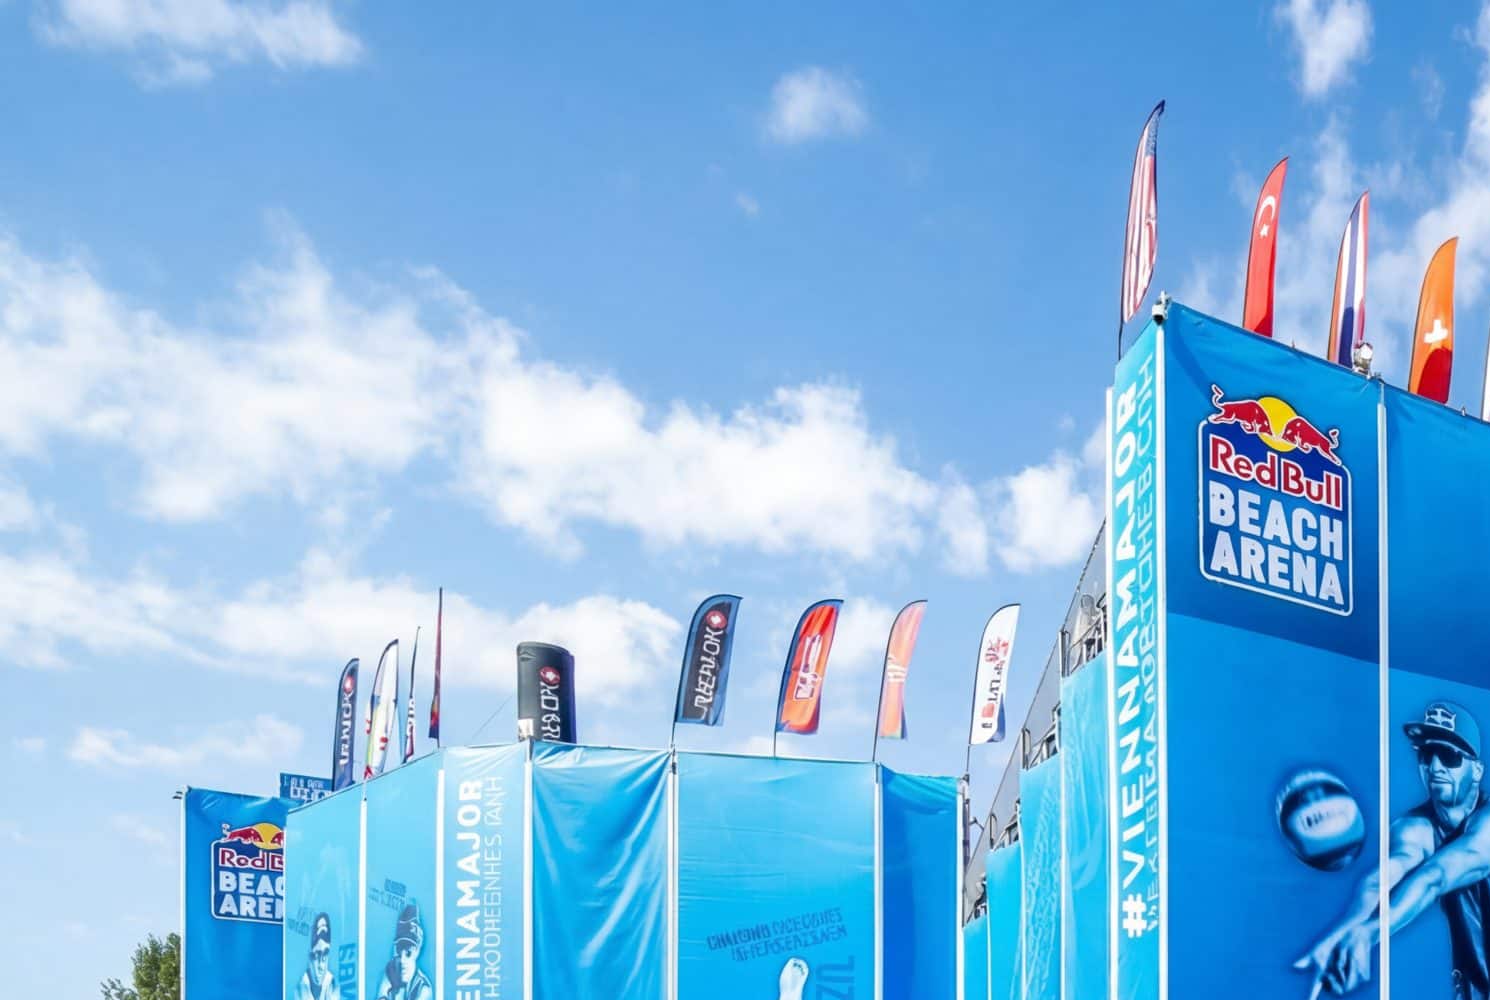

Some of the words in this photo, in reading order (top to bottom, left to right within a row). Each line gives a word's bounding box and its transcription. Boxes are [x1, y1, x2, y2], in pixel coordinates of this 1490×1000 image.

[1209, 480, 1344, 561] BEACH
[1210, 531, 1345, 605] ARENA
[1114, 382, 1147, 938] #VIENNAMAJOR
